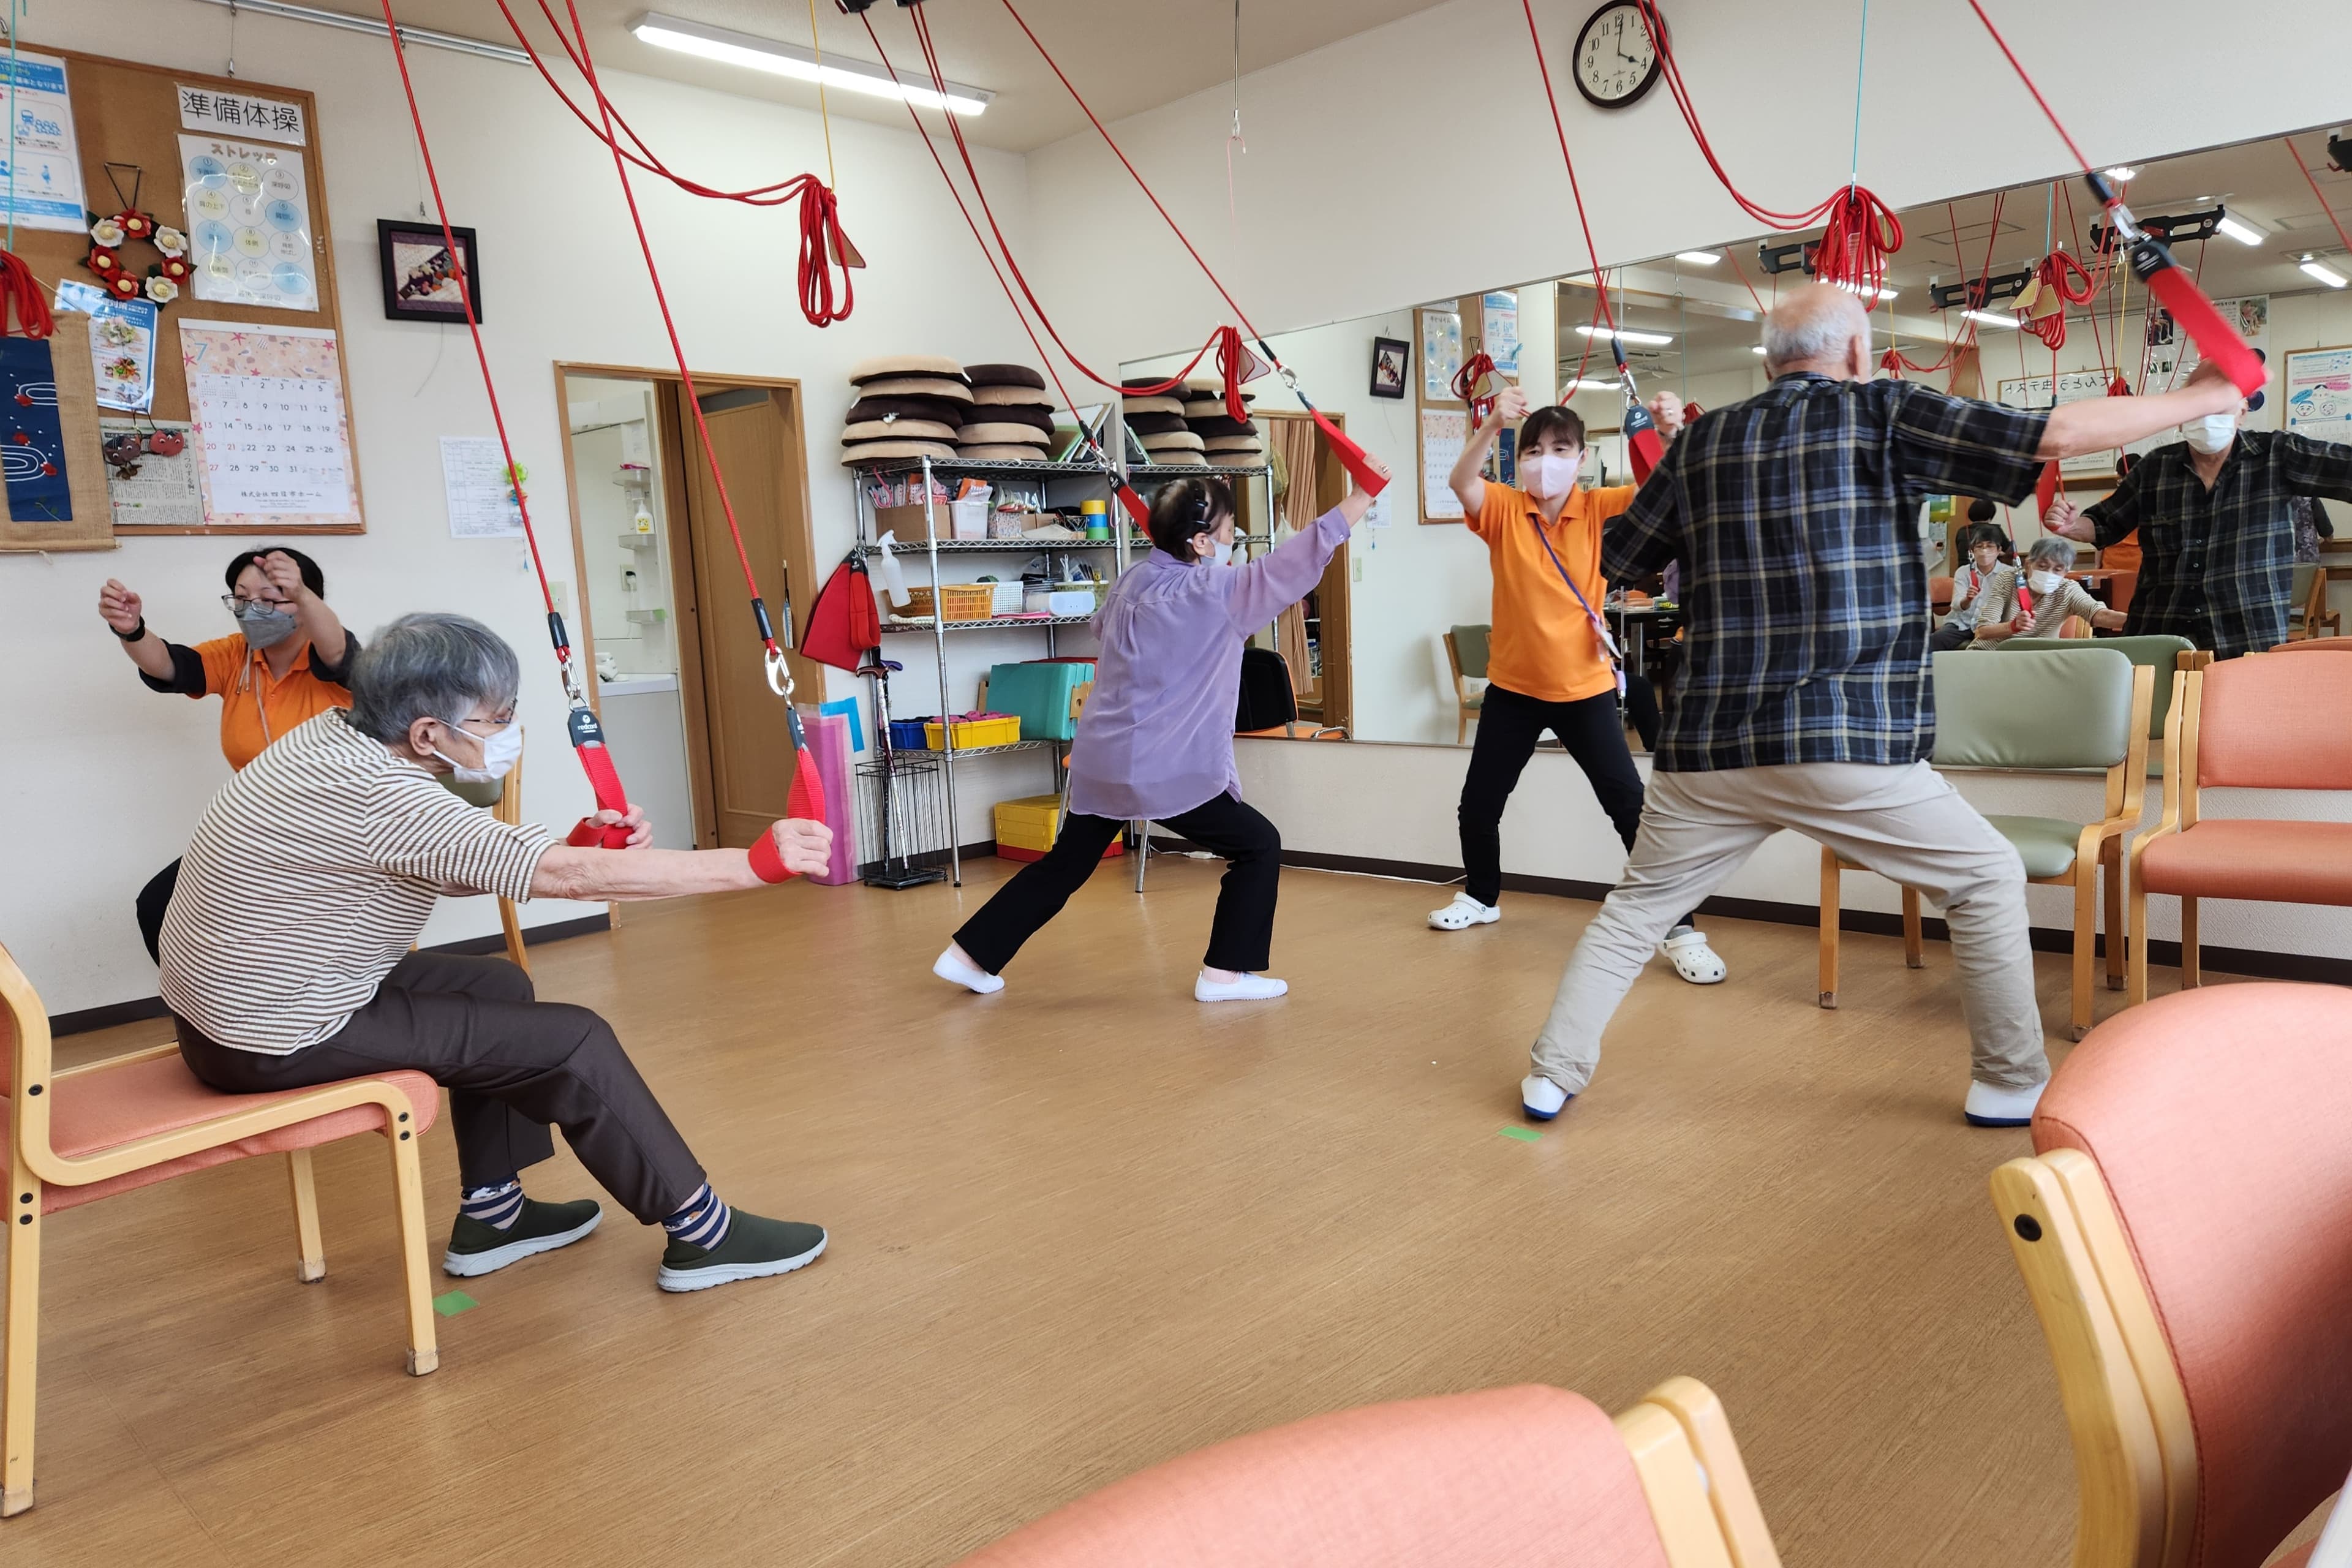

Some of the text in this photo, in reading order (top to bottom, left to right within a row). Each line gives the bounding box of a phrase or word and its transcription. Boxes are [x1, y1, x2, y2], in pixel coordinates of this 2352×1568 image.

[1615, 13, 1623, 28] 12
[1631, 15, 1634, 28] 1
[1602, 23, 1608, 36] 11
[1591, 37, 1600, 51] 10
[1646, 39, 1652, 52] 3
[1588, 55, 1594, 69] 9
[1640, 56, 1646, 70] 4
[1593, 70, 1599, 83] 8
[1629, 71, 1636, 85] 5
[1602, 80, 1609, 92] 7
[1616, 80, 1623, 92] 6
[182, 90, 299, 132] 準備体操
[211, 143, 277, 164] ストレッチ
[195, 343, 208, 361] 7
